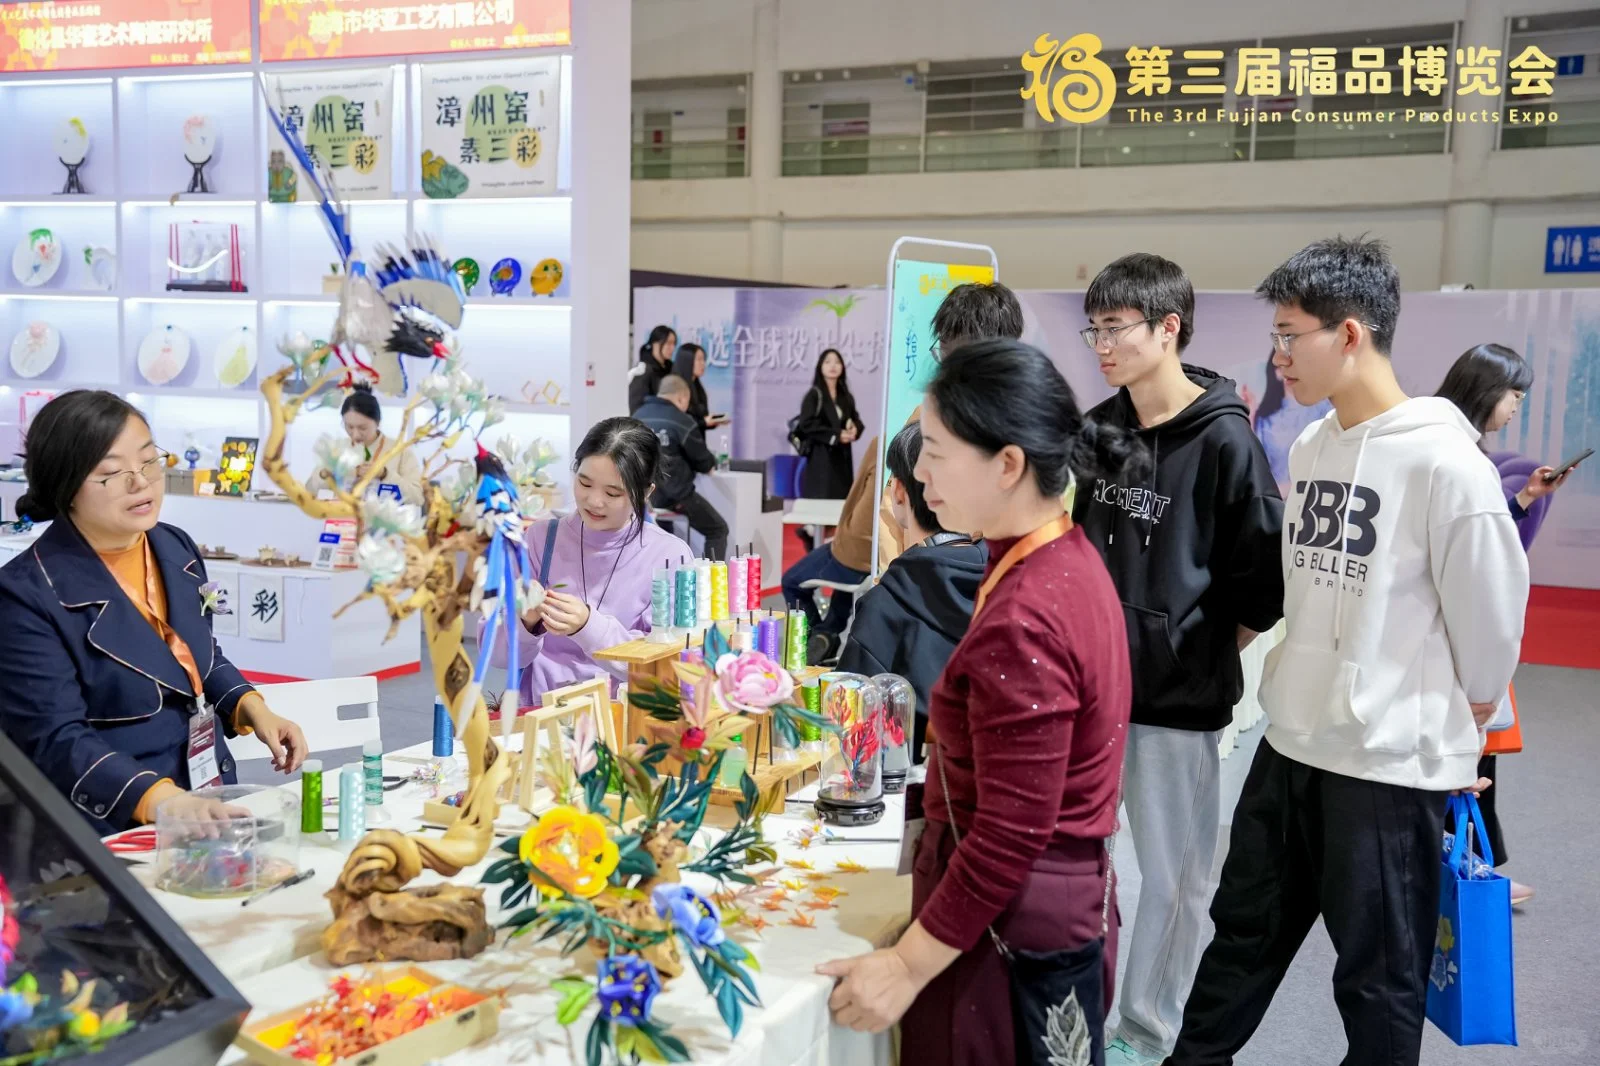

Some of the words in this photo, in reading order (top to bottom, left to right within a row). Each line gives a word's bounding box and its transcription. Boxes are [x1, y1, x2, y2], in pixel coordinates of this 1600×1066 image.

[436, 90, 529, 128] 漳州窑
[460, 135, 538, 163] 素三彩
[251, 588, 279, 625] 彩
